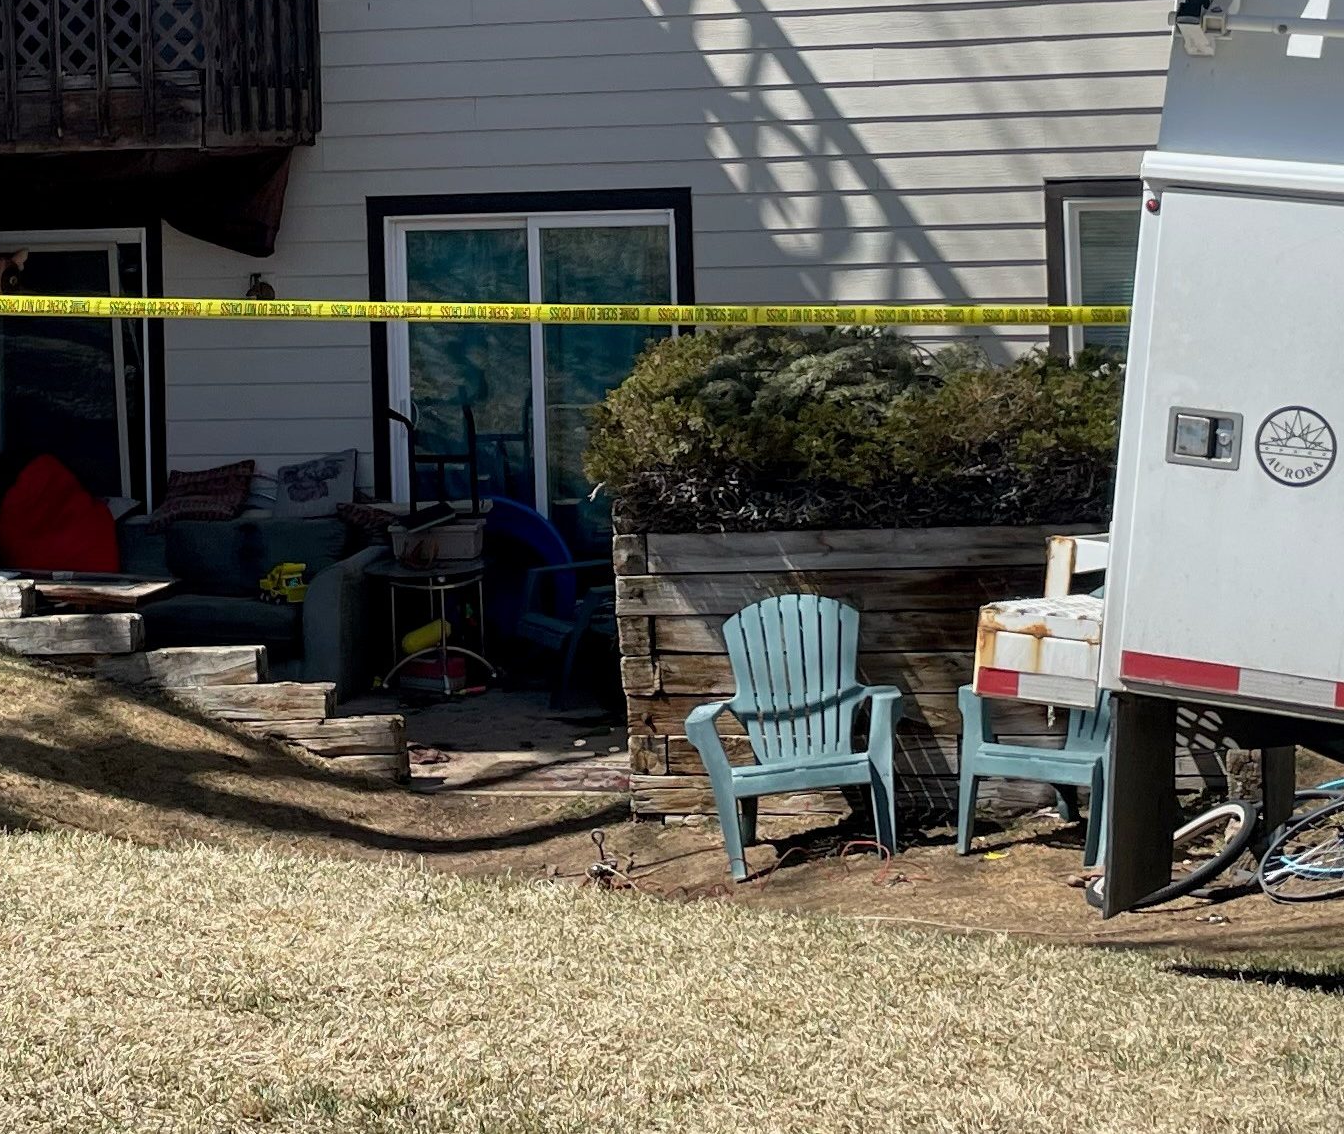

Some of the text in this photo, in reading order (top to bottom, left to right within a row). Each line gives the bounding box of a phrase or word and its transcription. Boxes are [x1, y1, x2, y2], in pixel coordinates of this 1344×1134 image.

[20, 298, 34, 312] NOT
[34, 299, 44, 312] DO
[45, 299, 68, 313] SCENE
[68, 300, 90, 313] CRIME
[108, 300, 201, 314] CRIME SCENE DO NOT CROSS
[220, 301, 311, 315] CRIME SCENE DO NOT CROSS
[330, 303, 421, 318] CRIME SCENE DO NOT CROSS
[439, 305, 530, 320] CRIME SCENE DO NOT CROSS
[549, 307, 639, 321] CRIME SCENE DO NOT CROSS
[657, 308, 747, 322] CRIME SCENE DO NOT CROSS
[766, 308, 856, 322] CRIME SCENE DO NOT CROSS
[874, 309, 964, 322] CRIME SCENE DO NOT CROSS
[982, 309, 1072, 322] CRIME SCENE DO NOT CROSS
[1266, 457, 1324, 480] AURORA
